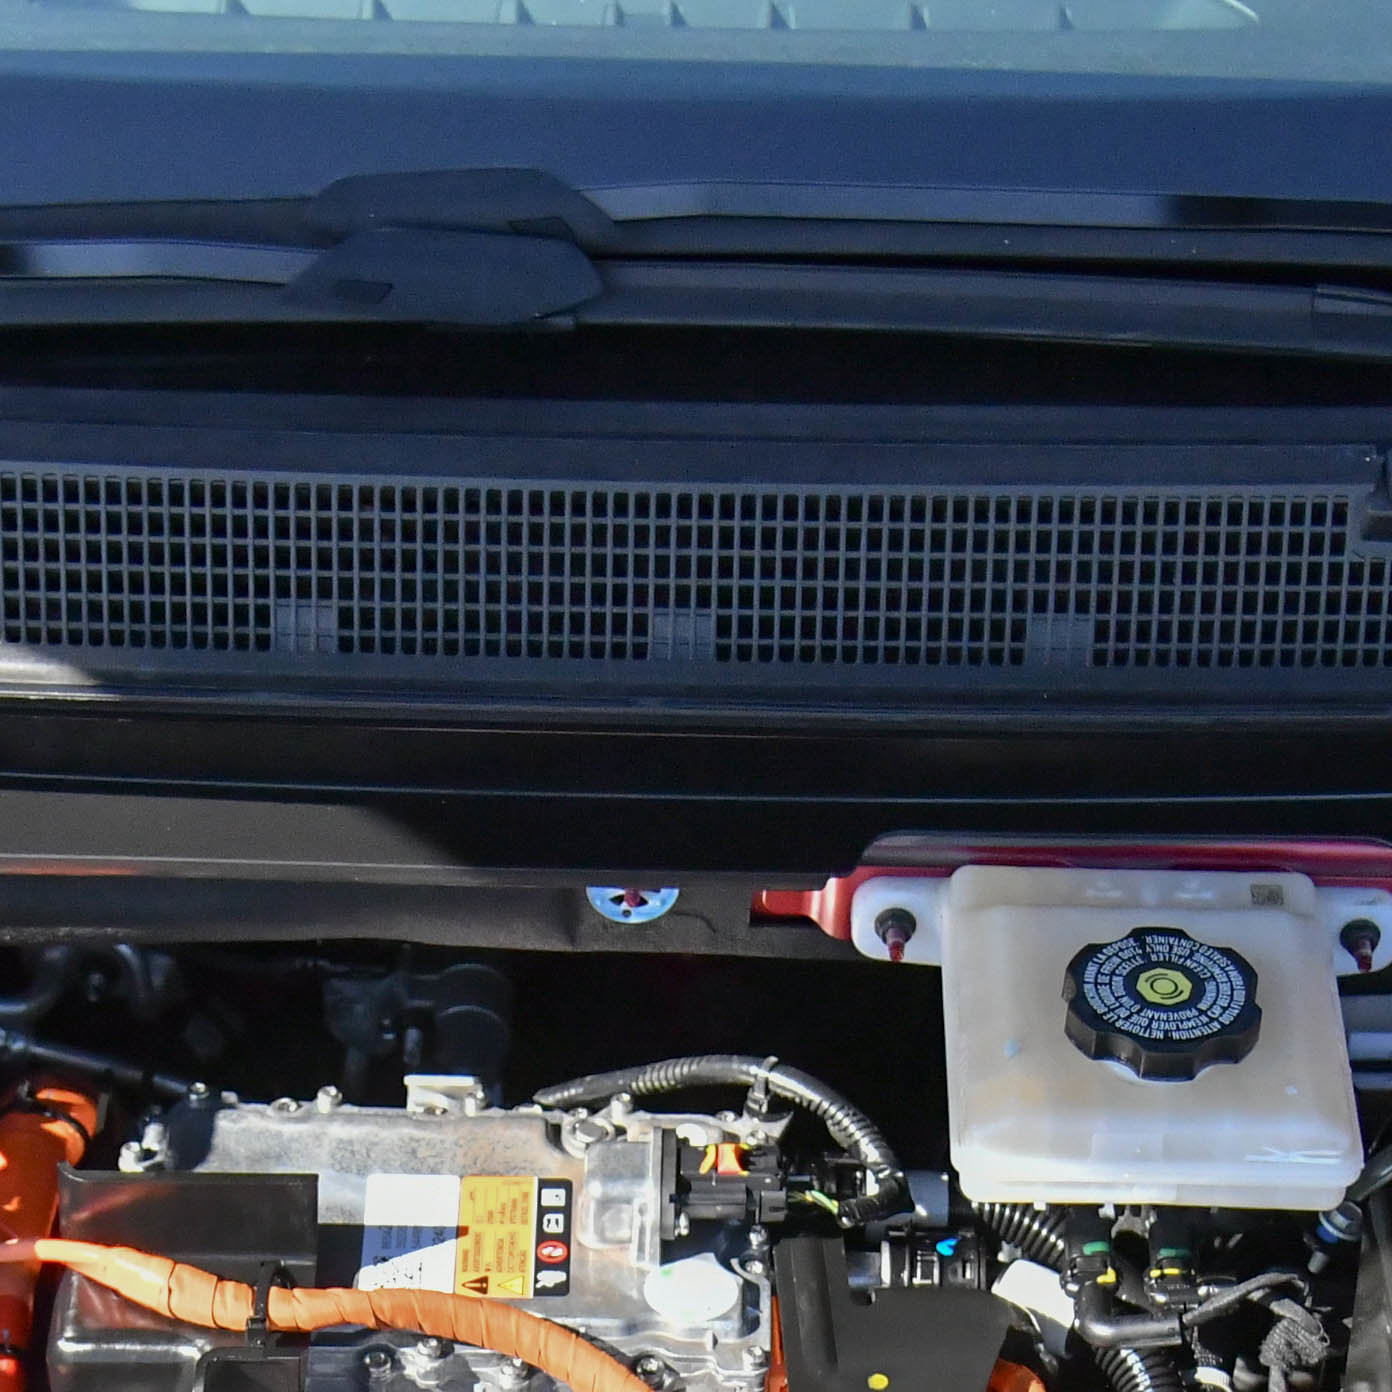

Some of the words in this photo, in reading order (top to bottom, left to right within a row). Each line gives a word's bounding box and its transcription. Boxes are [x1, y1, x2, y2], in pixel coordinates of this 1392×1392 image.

[1145, 944, 1169, 953] ONLY
[1172, 945, 1190, 956] USE
[1151, 953, 1184, 964] FILLER
[1184, 959, 1210, 978] CLEAN
[1103, 1012, 1117, 1023] LE
[1128, 1014, 1148, 1025] QUE
[1140, 1008, 1199, 1020] PROVENANT
[1115, 1019, 1164, 1039] NETTOYER
